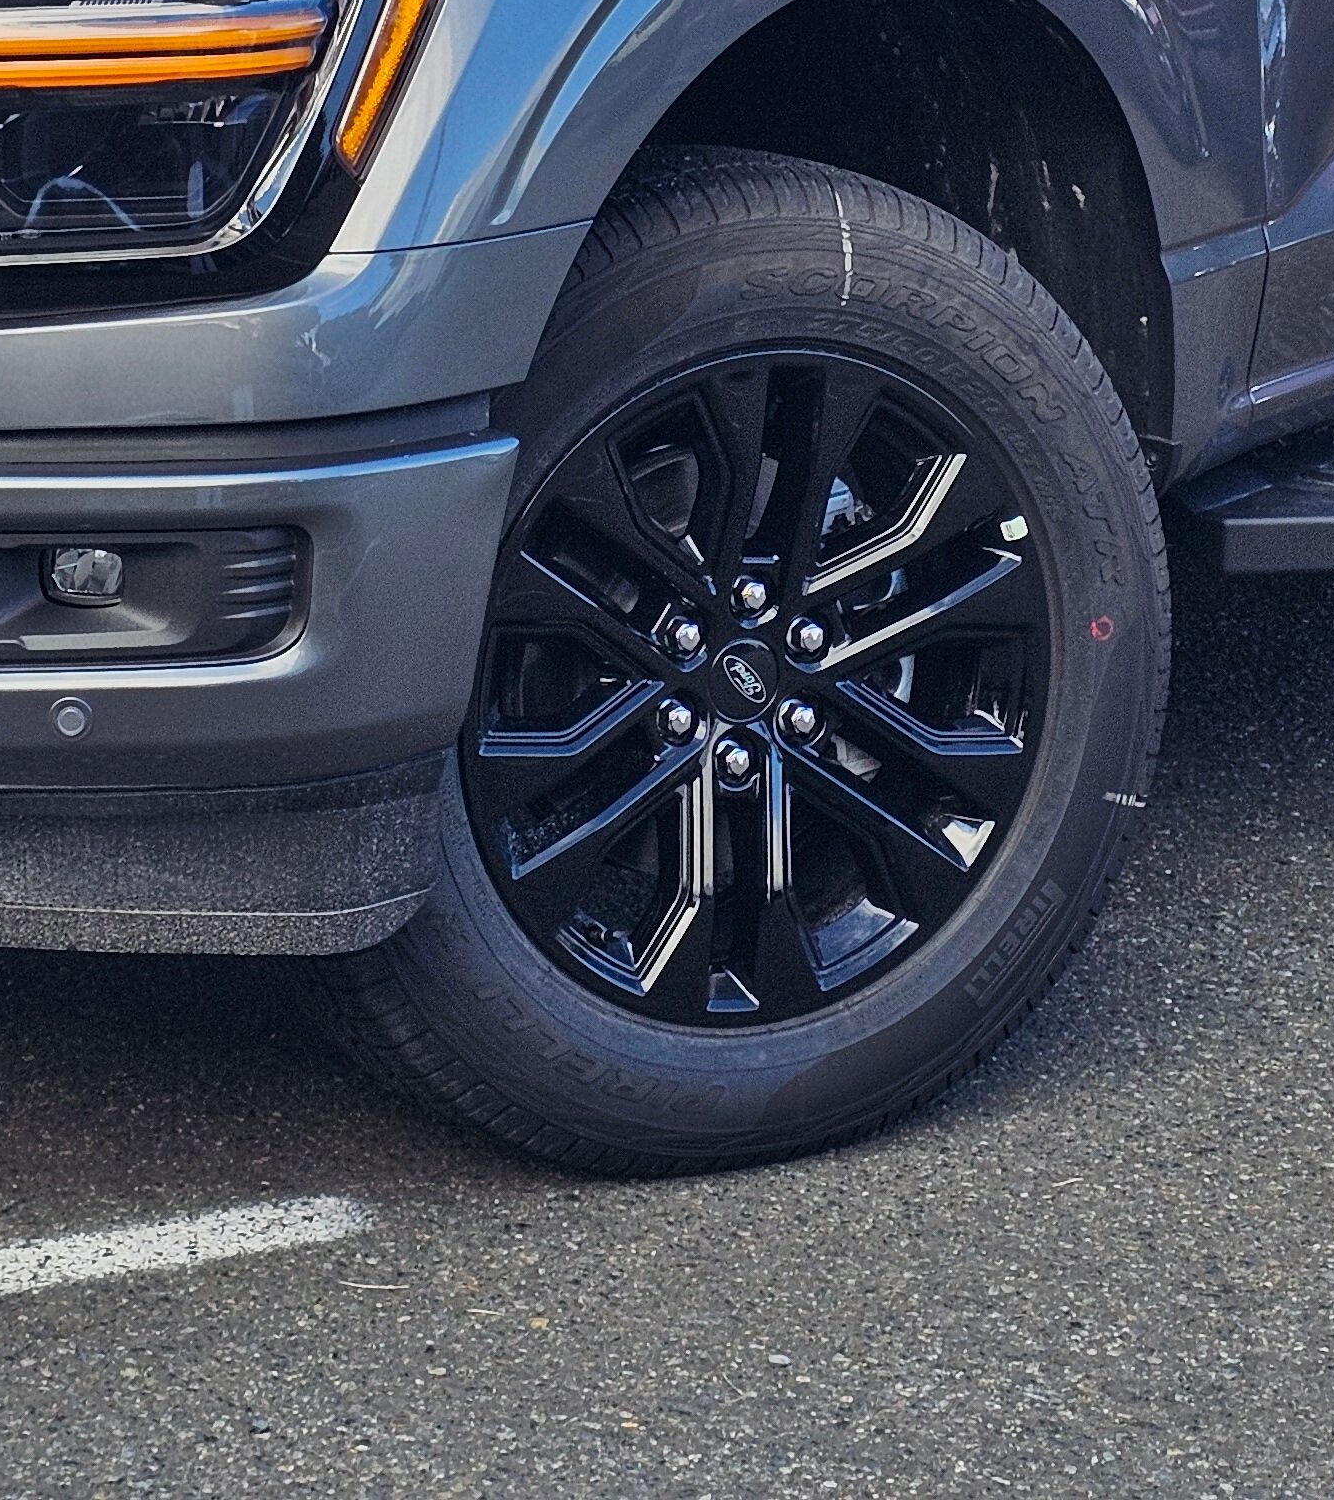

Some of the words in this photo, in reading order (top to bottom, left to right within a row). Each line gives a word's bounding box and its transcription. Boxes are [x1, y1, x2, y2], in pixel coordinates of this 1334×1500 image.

[739, 265, 1067, 426] SCORPION
[729, 662, 762, 696] Ford
[963, 878, 1066, 1008] PIRELLI
